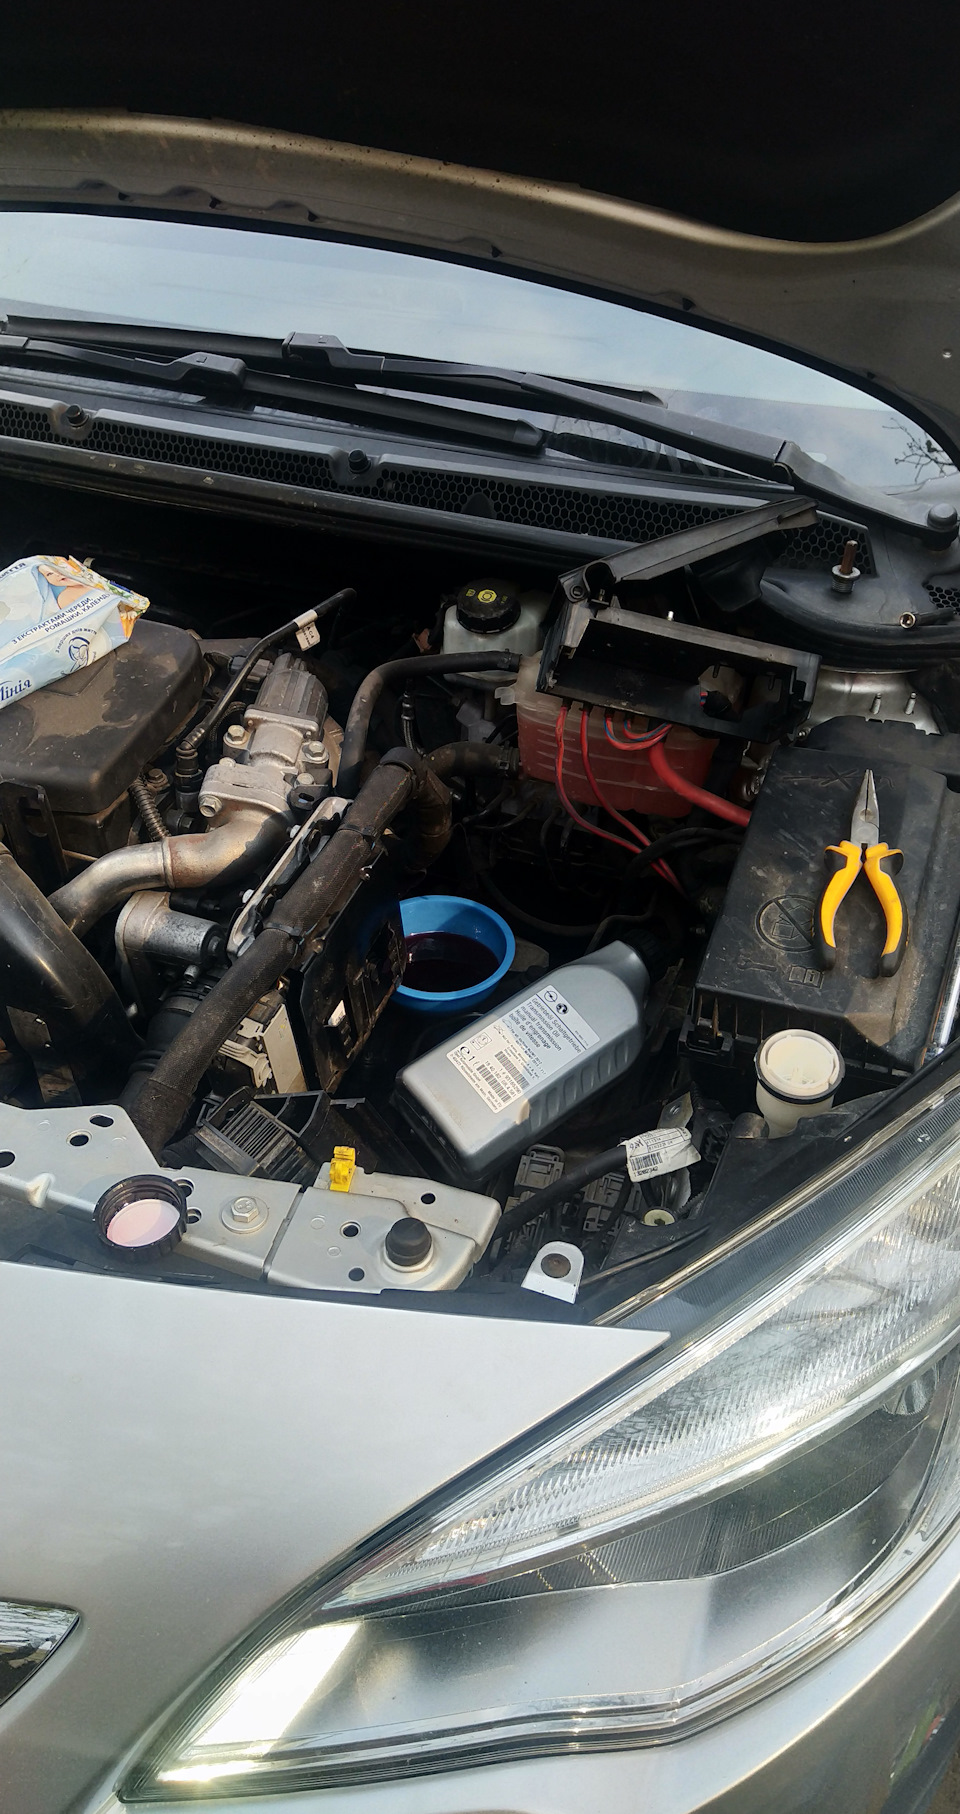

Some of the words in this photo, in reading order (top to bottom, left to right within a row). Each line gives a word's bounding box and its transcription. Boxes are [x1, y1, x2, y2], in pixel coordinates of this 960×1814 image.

[17, 612, 67, 641] ЕКСТРАКТАМИ
[66, 597, 93, 616] ЧЕРЕДИ,
[44, 611, 83, 633] РОМАШКИ,
[514, 1008, 527, 1021] Huile
[523, 1020, 552, 1050] d'engrenage
[520, 1005, 537, 1022] manual
[534, 1021, 562, 1051] transmission
[526, 1001, 554, 1031] Transmission
[531, 997, 554, 1020] Getriebeöl
[550, 1019, 583, 1053] Schaltgetriebe
[524, 1030, 541, 1048] vitesse
